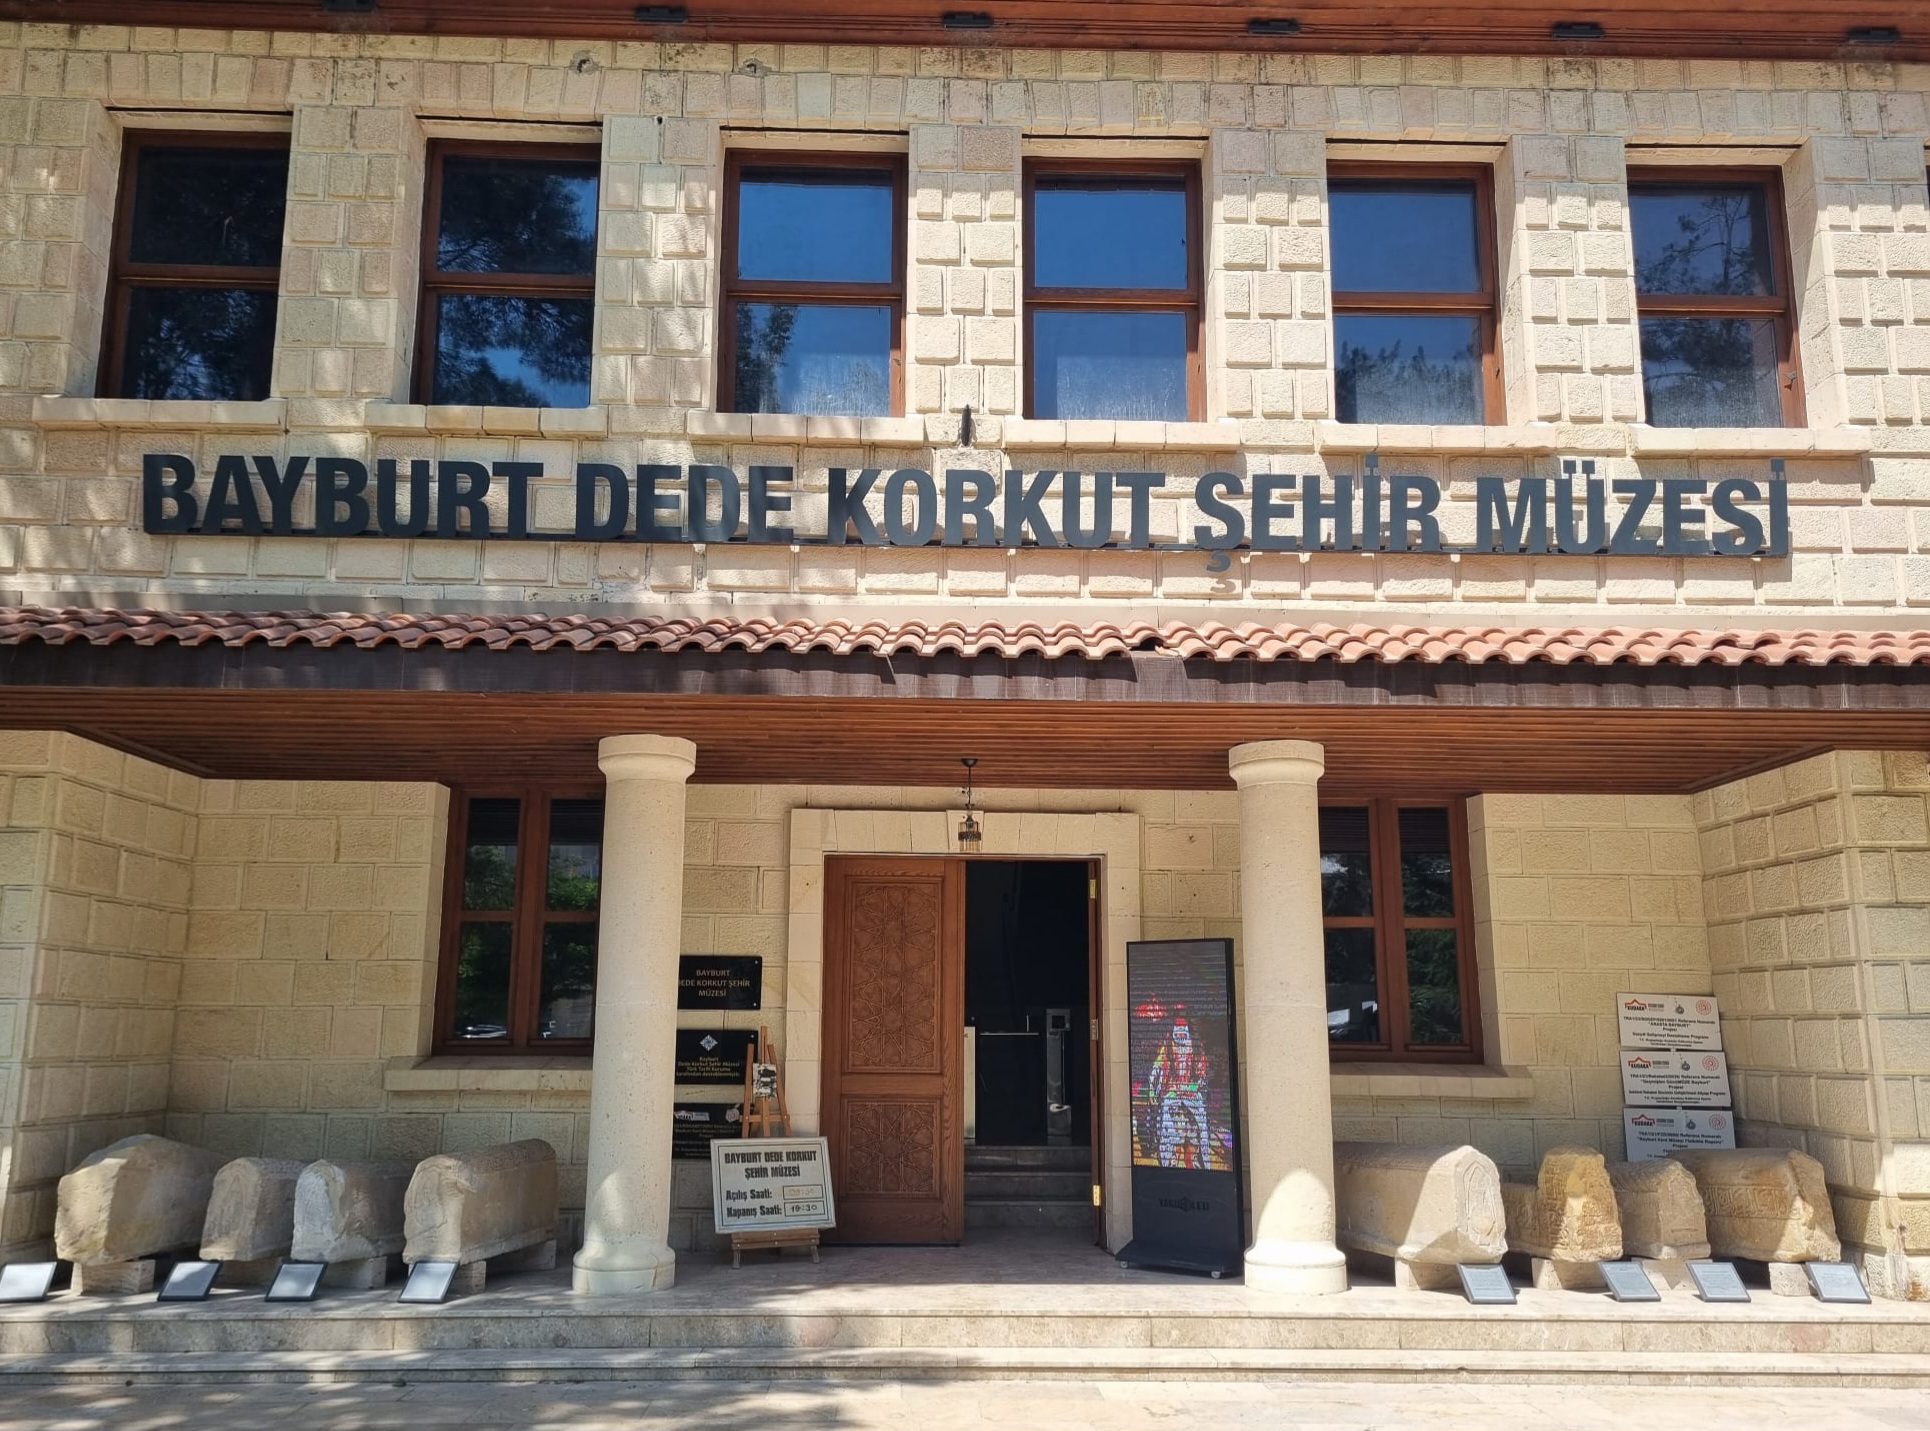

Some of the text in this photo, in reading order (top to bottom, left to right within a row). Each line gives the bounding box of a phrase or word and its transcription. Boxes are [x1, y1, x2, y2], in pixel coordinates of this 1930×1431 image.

[143, 455, 1789, 573] BAYBURT DEDE KORKUT ŞEHİR MÜZESİ
[696, 969, 731, 977] BAYBURT
[678, 978, 751, 989] EDE KORKUT ŞEHİR
[698, 988, 727, 997] MÜZESİ
[724, 1152, 762, 1164] BAYBURT
[764, 1151, 784, 1163] DEDE
[786, 1150, 817, 1161] KORKUT
[744, 1163, 801, 1181] ŞEHİR MÜZESİ
[726, 1189, 748, 1202] Açılış
[726, 1206, 757, 1219] Kapanış
